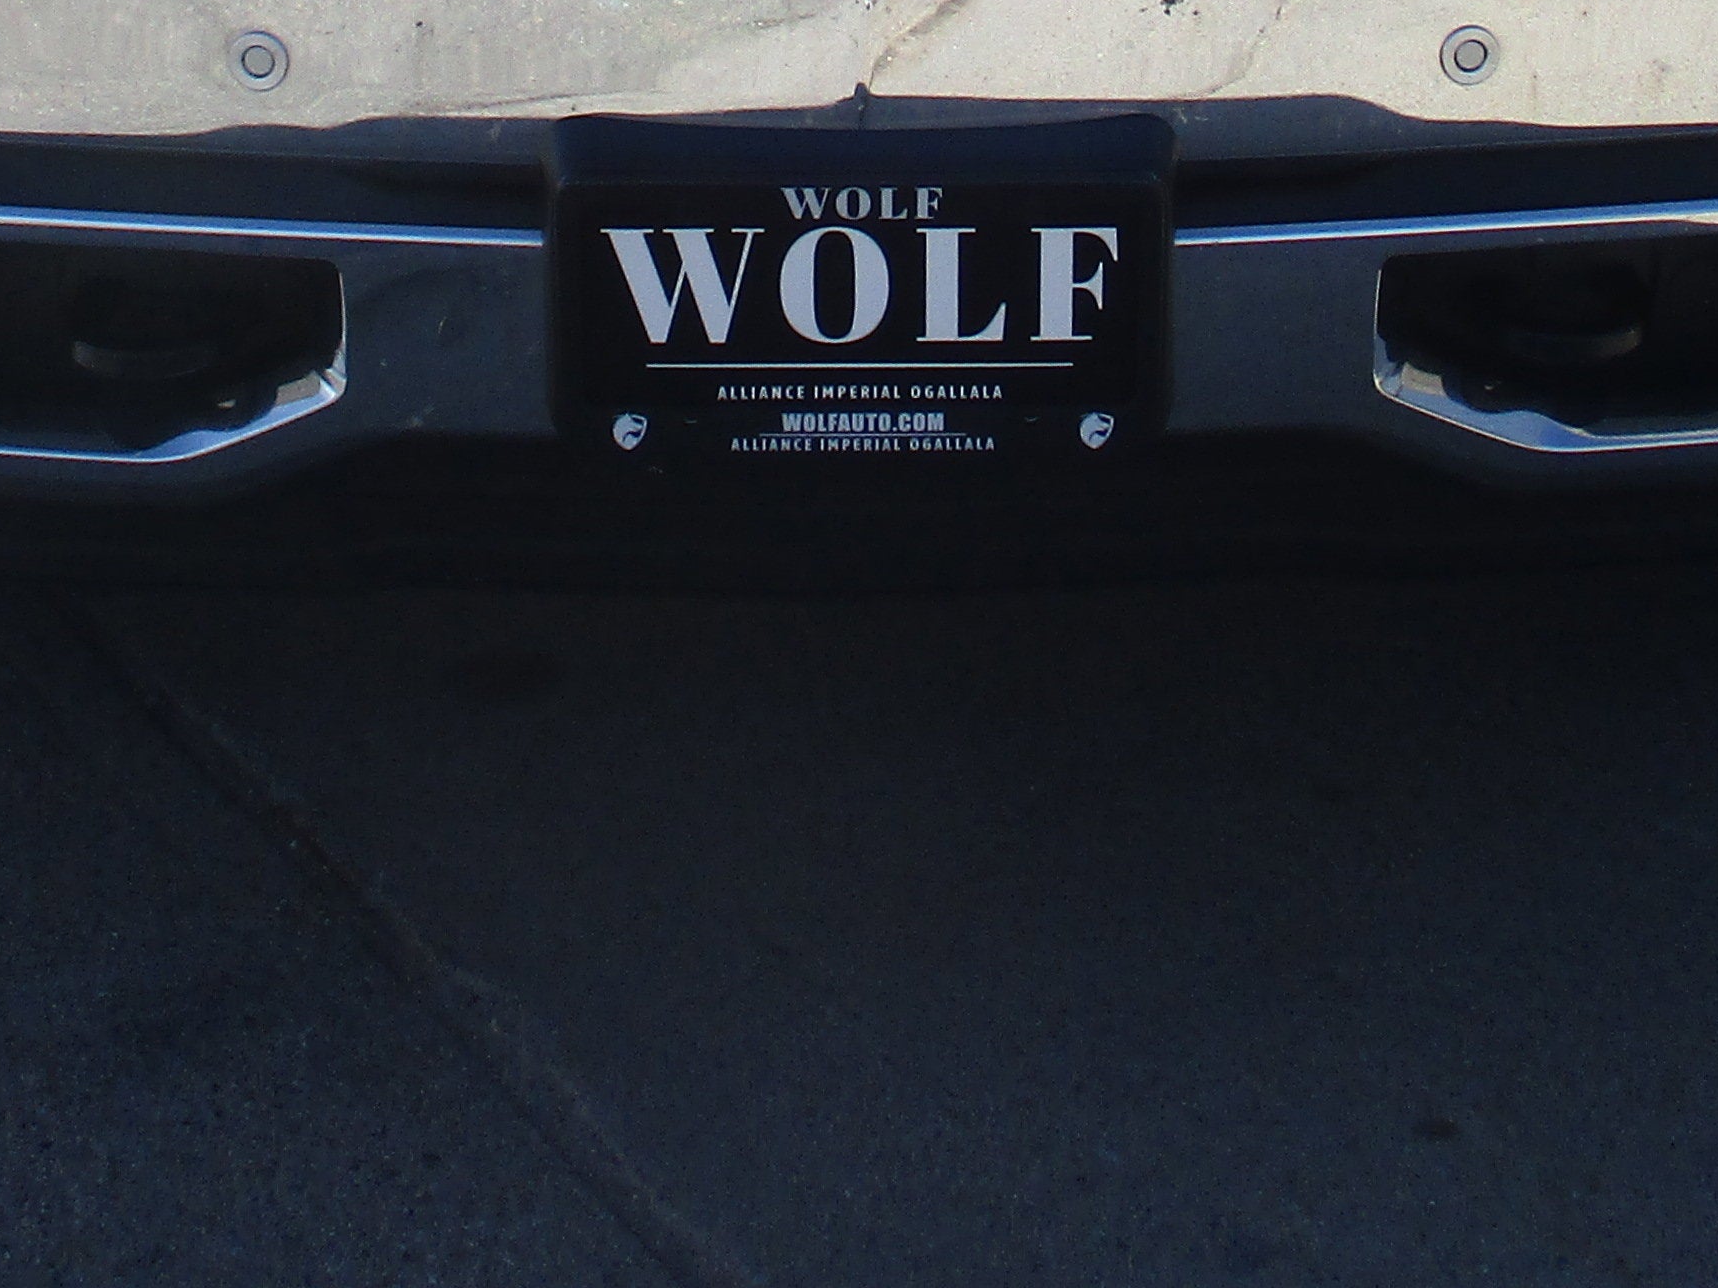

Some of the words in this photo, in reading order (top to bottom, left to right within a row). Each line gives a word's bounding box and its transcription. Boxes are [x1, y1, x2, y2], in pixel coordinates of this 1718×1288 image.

[780, 186, 943, 220] WOLF
[599, 226, 1119, 344] WOLF
[717, 385, 806, 400] ALLIANCE
[814, 385, 901, 400] IMPERIAL
[910, 385, 1003, 400] OGALLALA
[781, 412, 945, 433] WOLFAUTO.COM
[730, 437, 812, 452] ALLIANCE
[820, 437, 901, 452] IMPERIAL
[909, 437, 995, 452] OGALLALA
